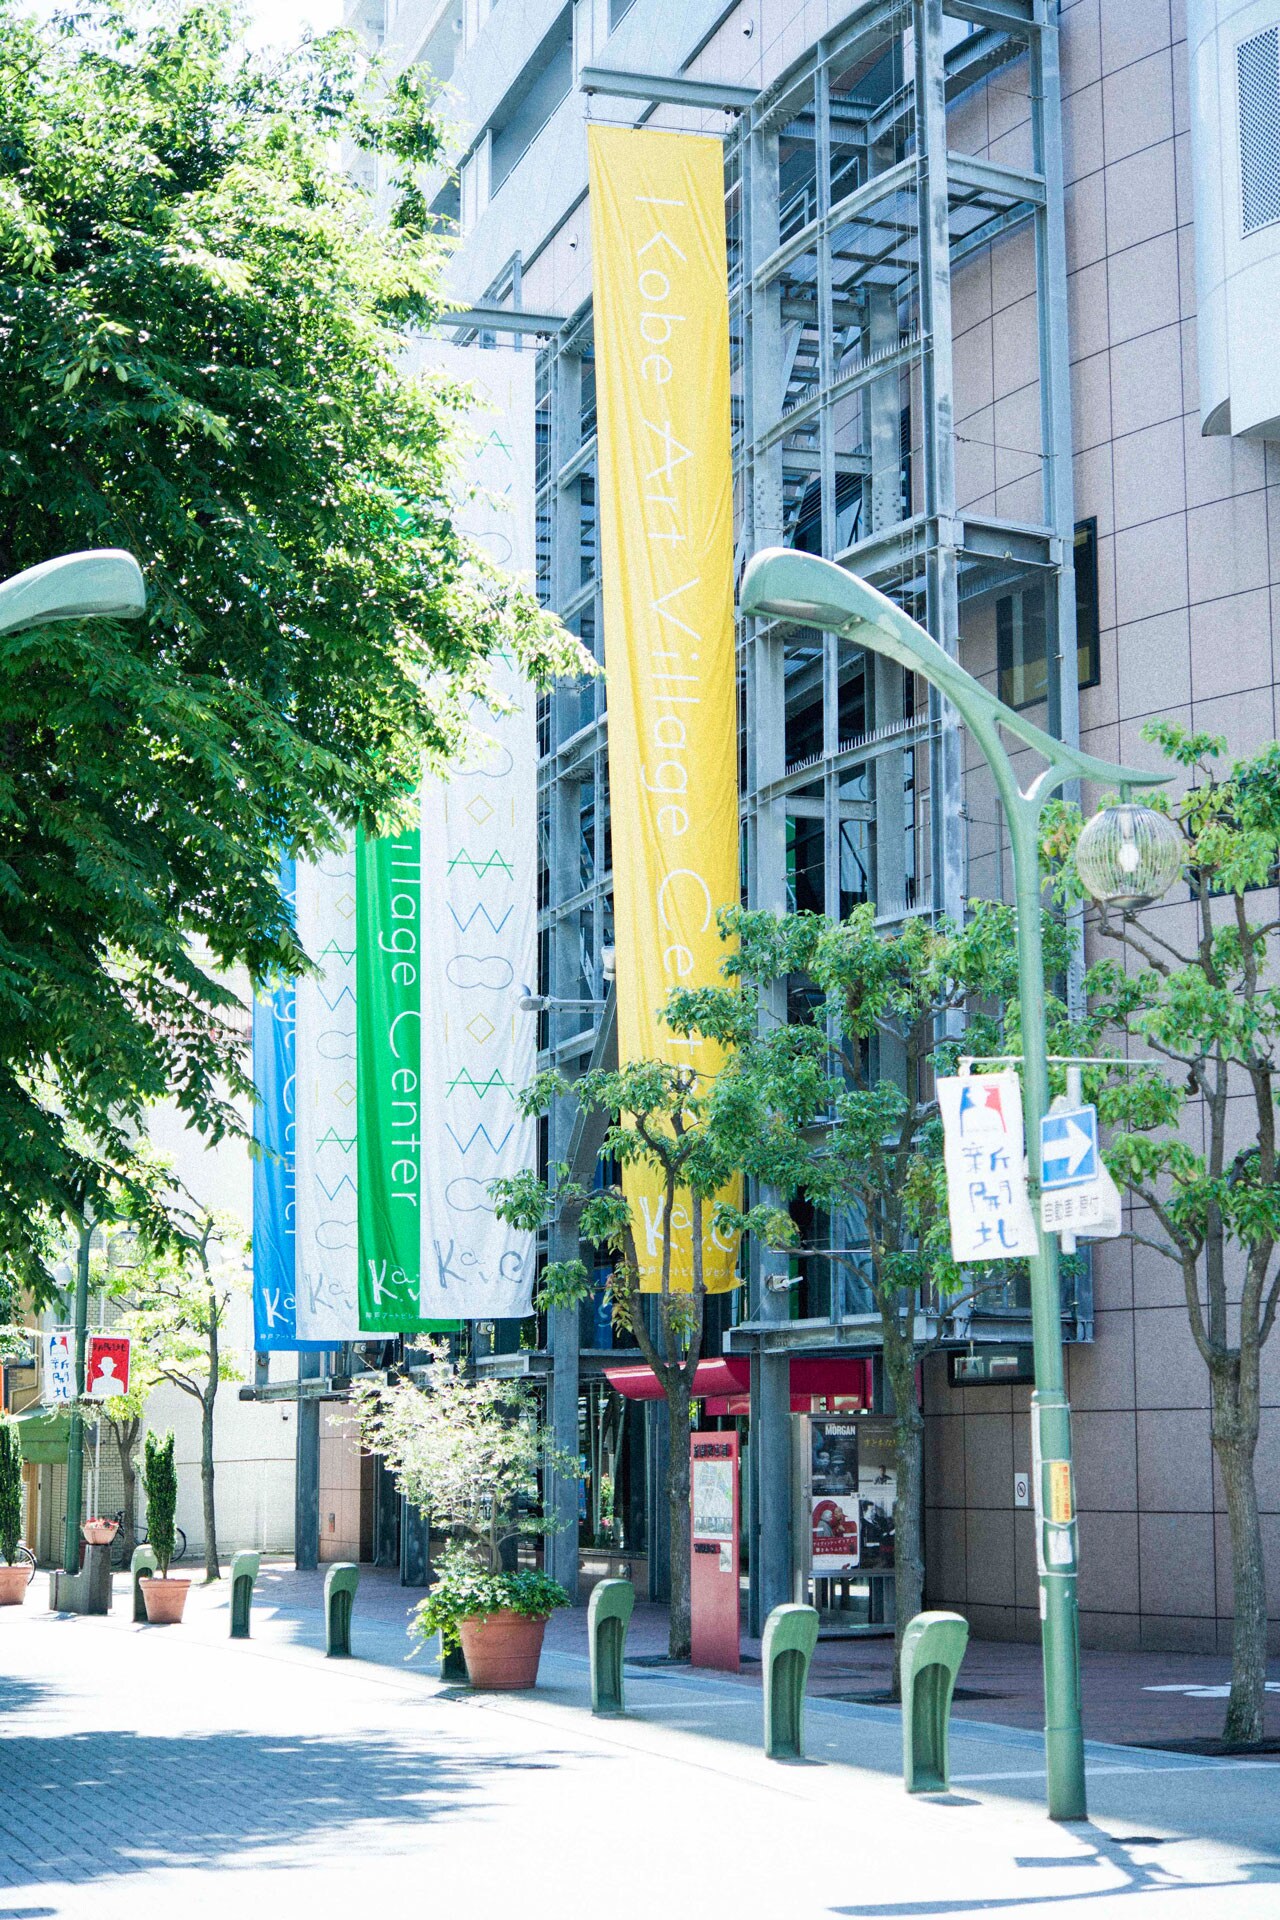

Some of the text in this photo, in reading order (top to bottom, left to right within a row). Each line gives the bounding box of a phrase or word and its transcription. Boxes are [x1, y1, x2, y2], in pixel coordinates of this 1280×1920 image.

[642, 418, 695, 548] Art
[640, 576, 701, 837] Village
[378, 844, 421, 1207] illage Center
[961, 1141, 1019, 1250] 新開地
[50, 1357, 71, 1399] 新開地
[825, 1424, 856, 1436] MORGAN
